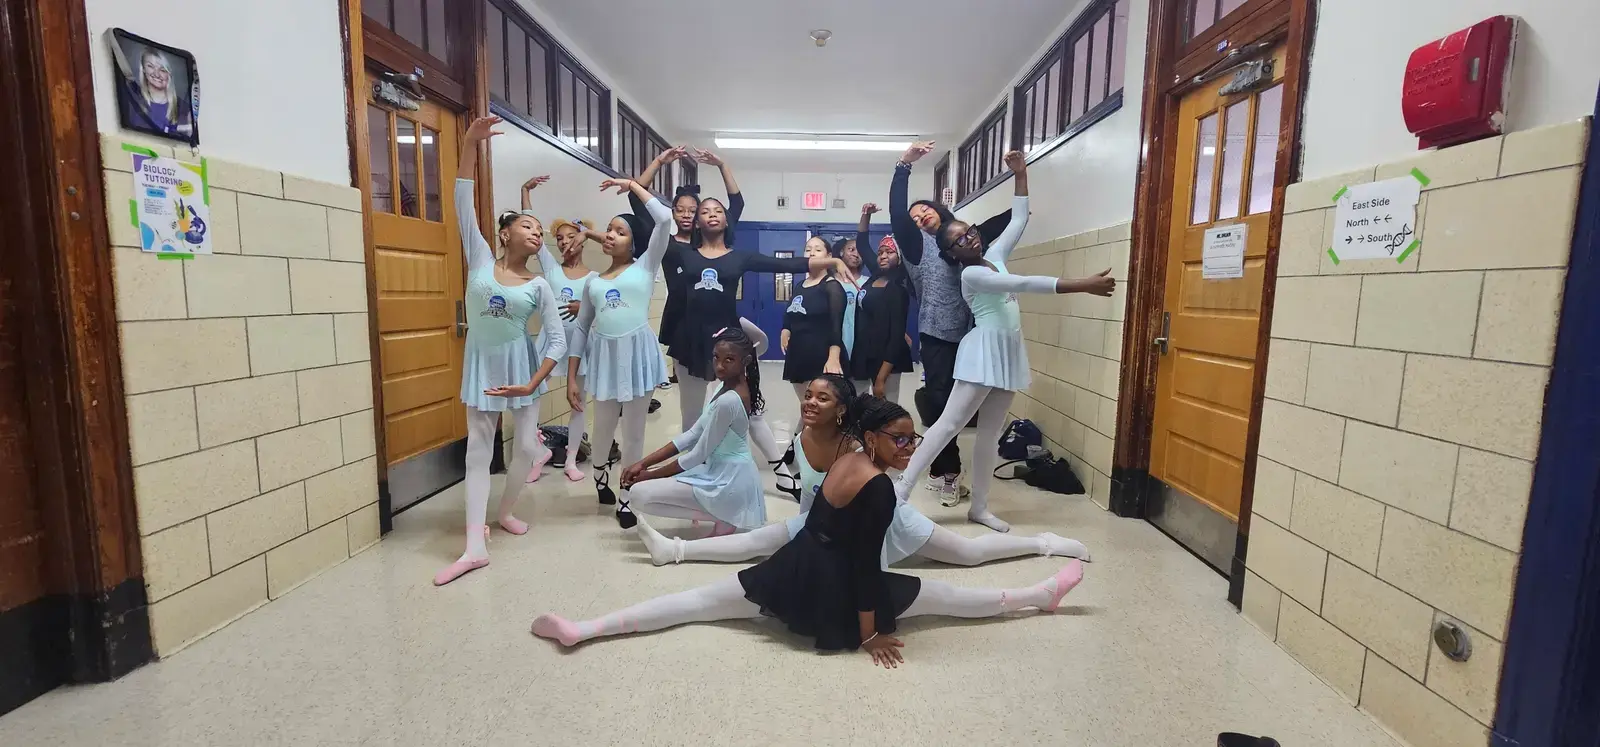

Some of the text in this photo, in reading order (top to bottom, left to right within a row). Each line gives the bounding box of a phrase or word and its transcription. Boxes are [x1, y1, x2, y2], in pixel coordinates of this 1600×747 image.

[143, 164, 176, 176] BIOLOGY
[144, 173, 183, 187] TUTORING
[805, 193, 823, 208] EXIT
[1352, 198, 1390, 210] East Side
[1346, 218, 1369, 228] North
[1367, 232, 1393, 243] South
